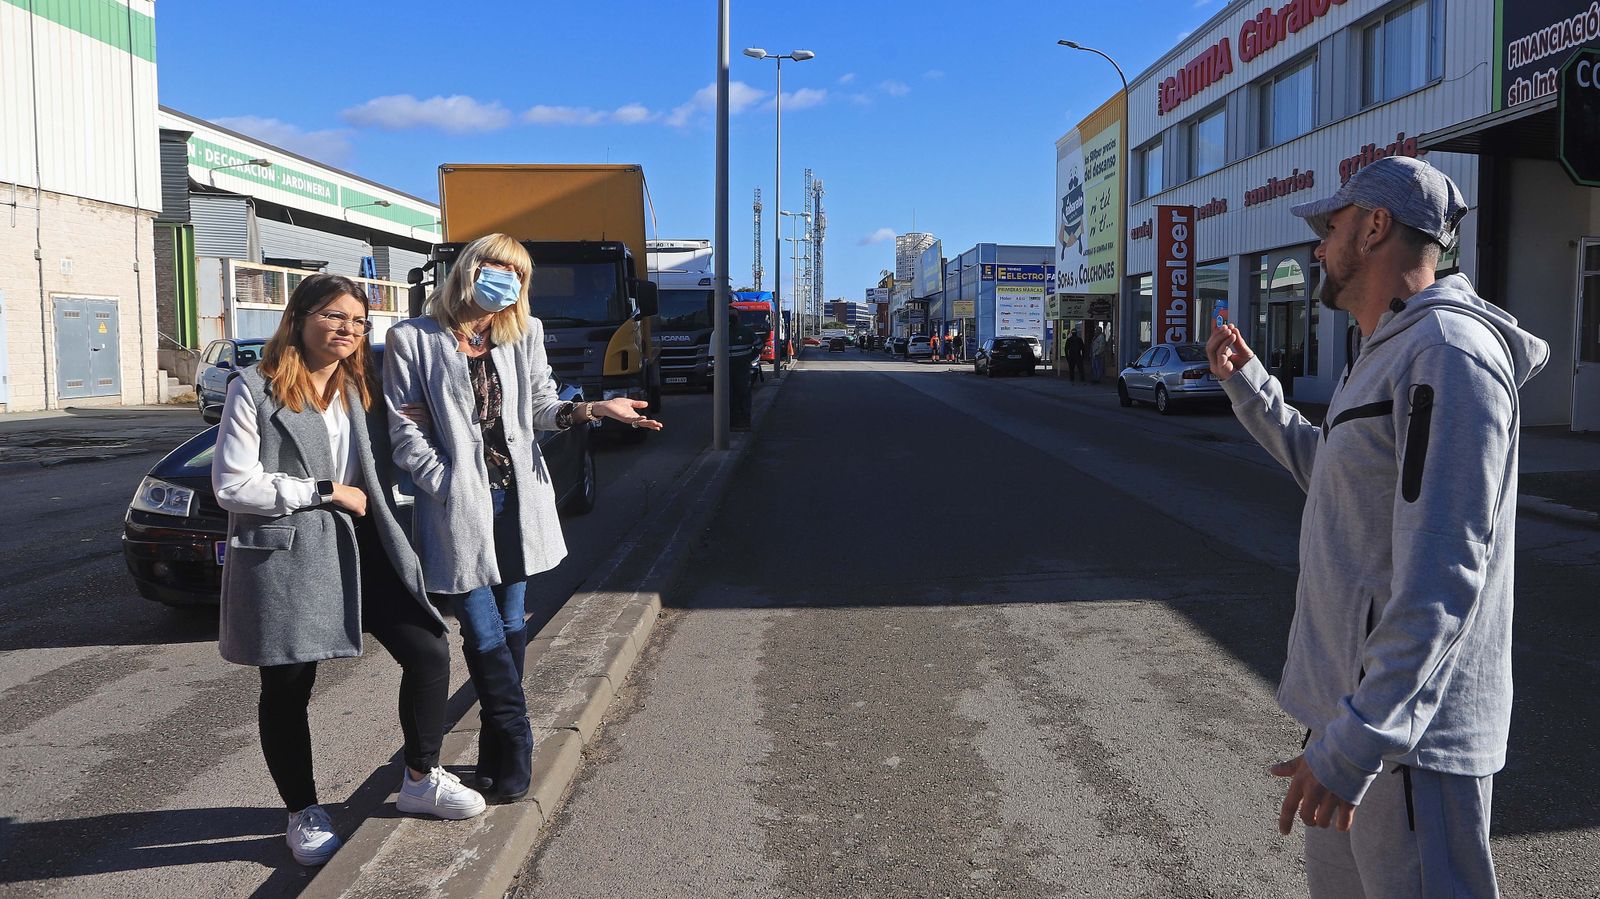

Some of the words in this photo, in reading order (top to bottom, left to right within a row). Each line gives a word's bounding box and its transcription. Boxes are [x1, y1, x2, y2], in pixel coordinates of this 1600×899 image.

[1238, 0, 1347, 63] Gibralc
[1508, 2, 1600, 70] FINANCIACIÓ
[1508, 77, 1531, 107] sin
[1093, 154, 1117, 177] descanso
[1244, 168, 1314, 207] sanitarios
[1079, 261, 1115, 285] COLCHONES
[1165, 210, 1188, 345] Gibralcer
